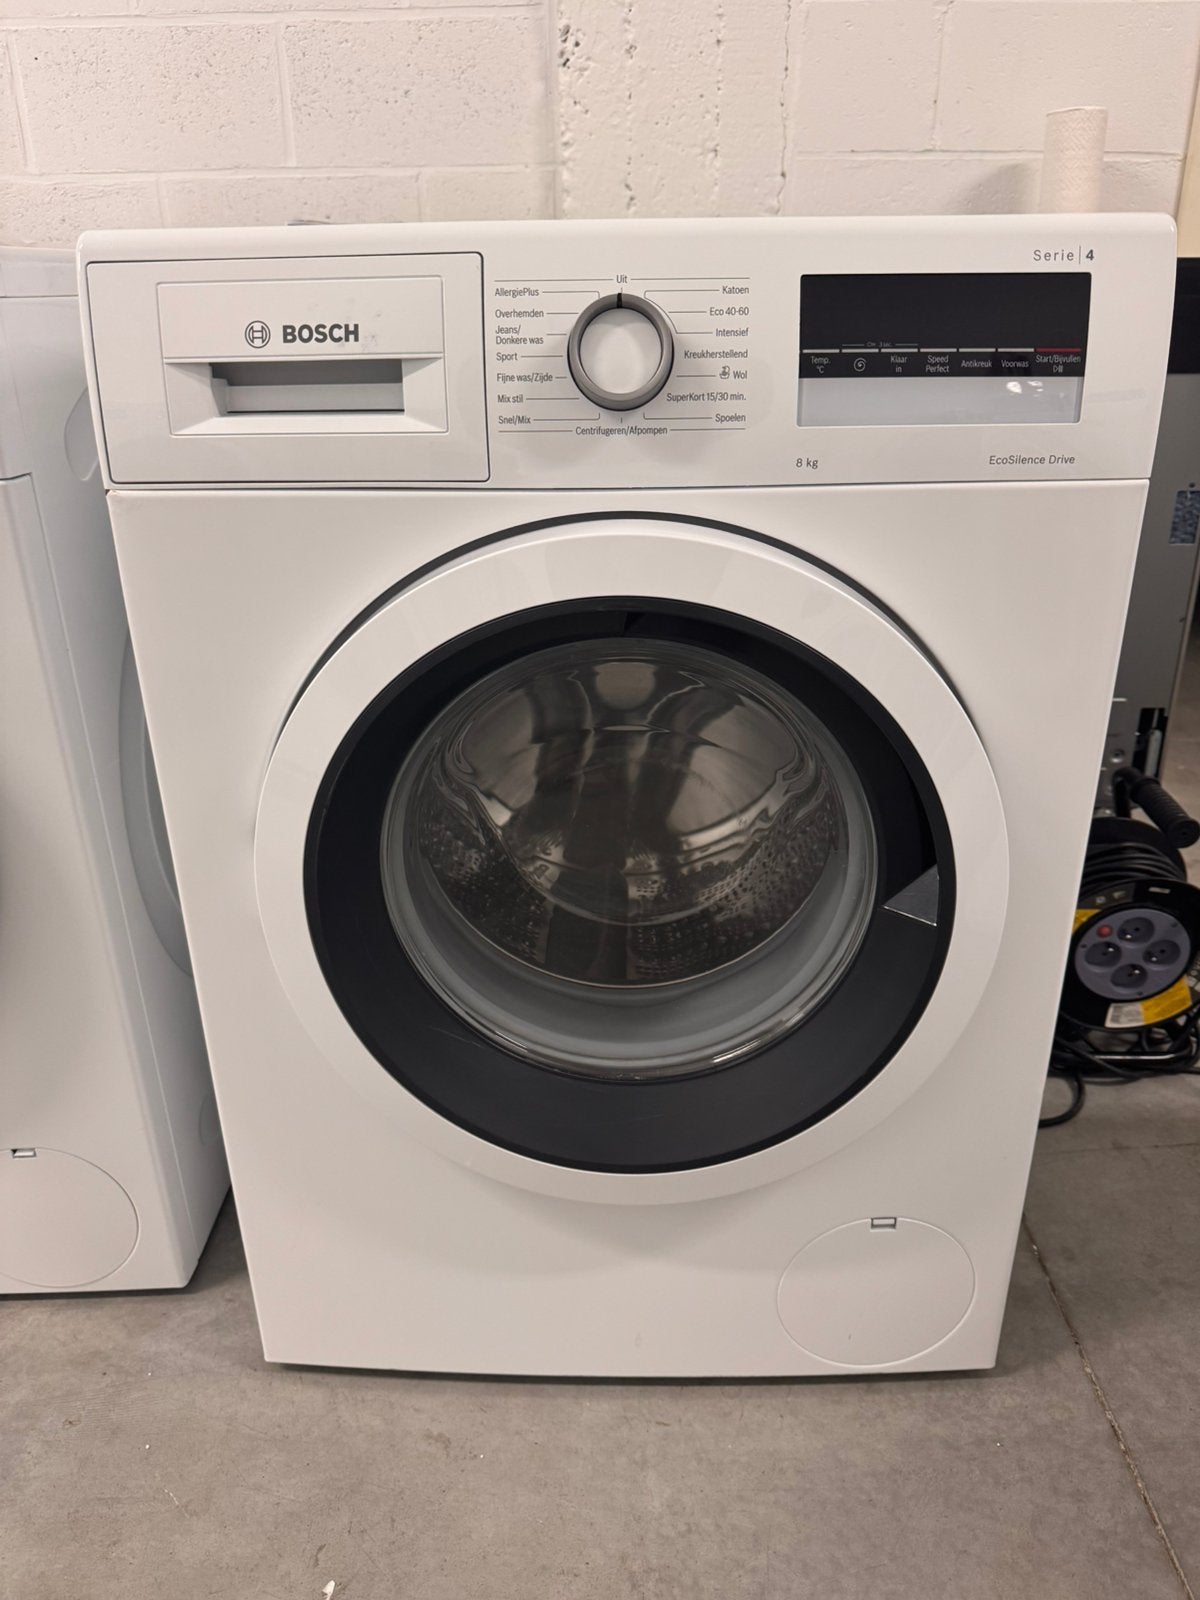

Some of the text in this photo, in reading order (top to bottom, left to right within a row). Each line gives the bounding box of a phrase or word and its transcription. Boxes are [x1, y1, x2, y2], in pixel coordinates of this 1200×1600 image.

[1033, 248, 1095, 262] Serie 4
[616, 274, 628, 284] Uit
[494, 287, 540, 299] AllergiePlus
[722, 285, 750, 295] Katoen
[494, 309, 545, 319] Overhemden
[709, 306, 750, 317] Eco 40-60
[282, 323, 360, 344] BOSCH
[495, 324, 522, 336] Jeans/
[715, 327, 750, 338] Intensief
[495, 335, 544, 346] Donkere was
[496, 351, 518, 363] Sport
[683, 349, 749, 360] Kreukherstellend
[890, 354, 908, 364] Klaar
[927, 354, 950, 365] Speed
[810, 355, 832, 366] Temp.
[960, 359, 993, 369] Antikreuk
[1001, 359, 1030, 369] Voorwas
[895, 364, 902, 373] in
[925, 364, 950, 373] Perfect
[496, 372, 554, 384] Fijne was/Zijde
[733, 370, 748, 380] Wol
[497, 393, 524, 404] Mix stil
[666, 391, 747, 404] SuperKort 15/30 min.
[498, 414, 532, 426] Snel/Mix
[715, 413, 747, 424] Spoelen
[575, 425, 668, 438] Centrifugeren/Afpompen
[796, 457, 819, 470] 8 kg
[988, 454, 1076, 466] EcoSilence Drive
